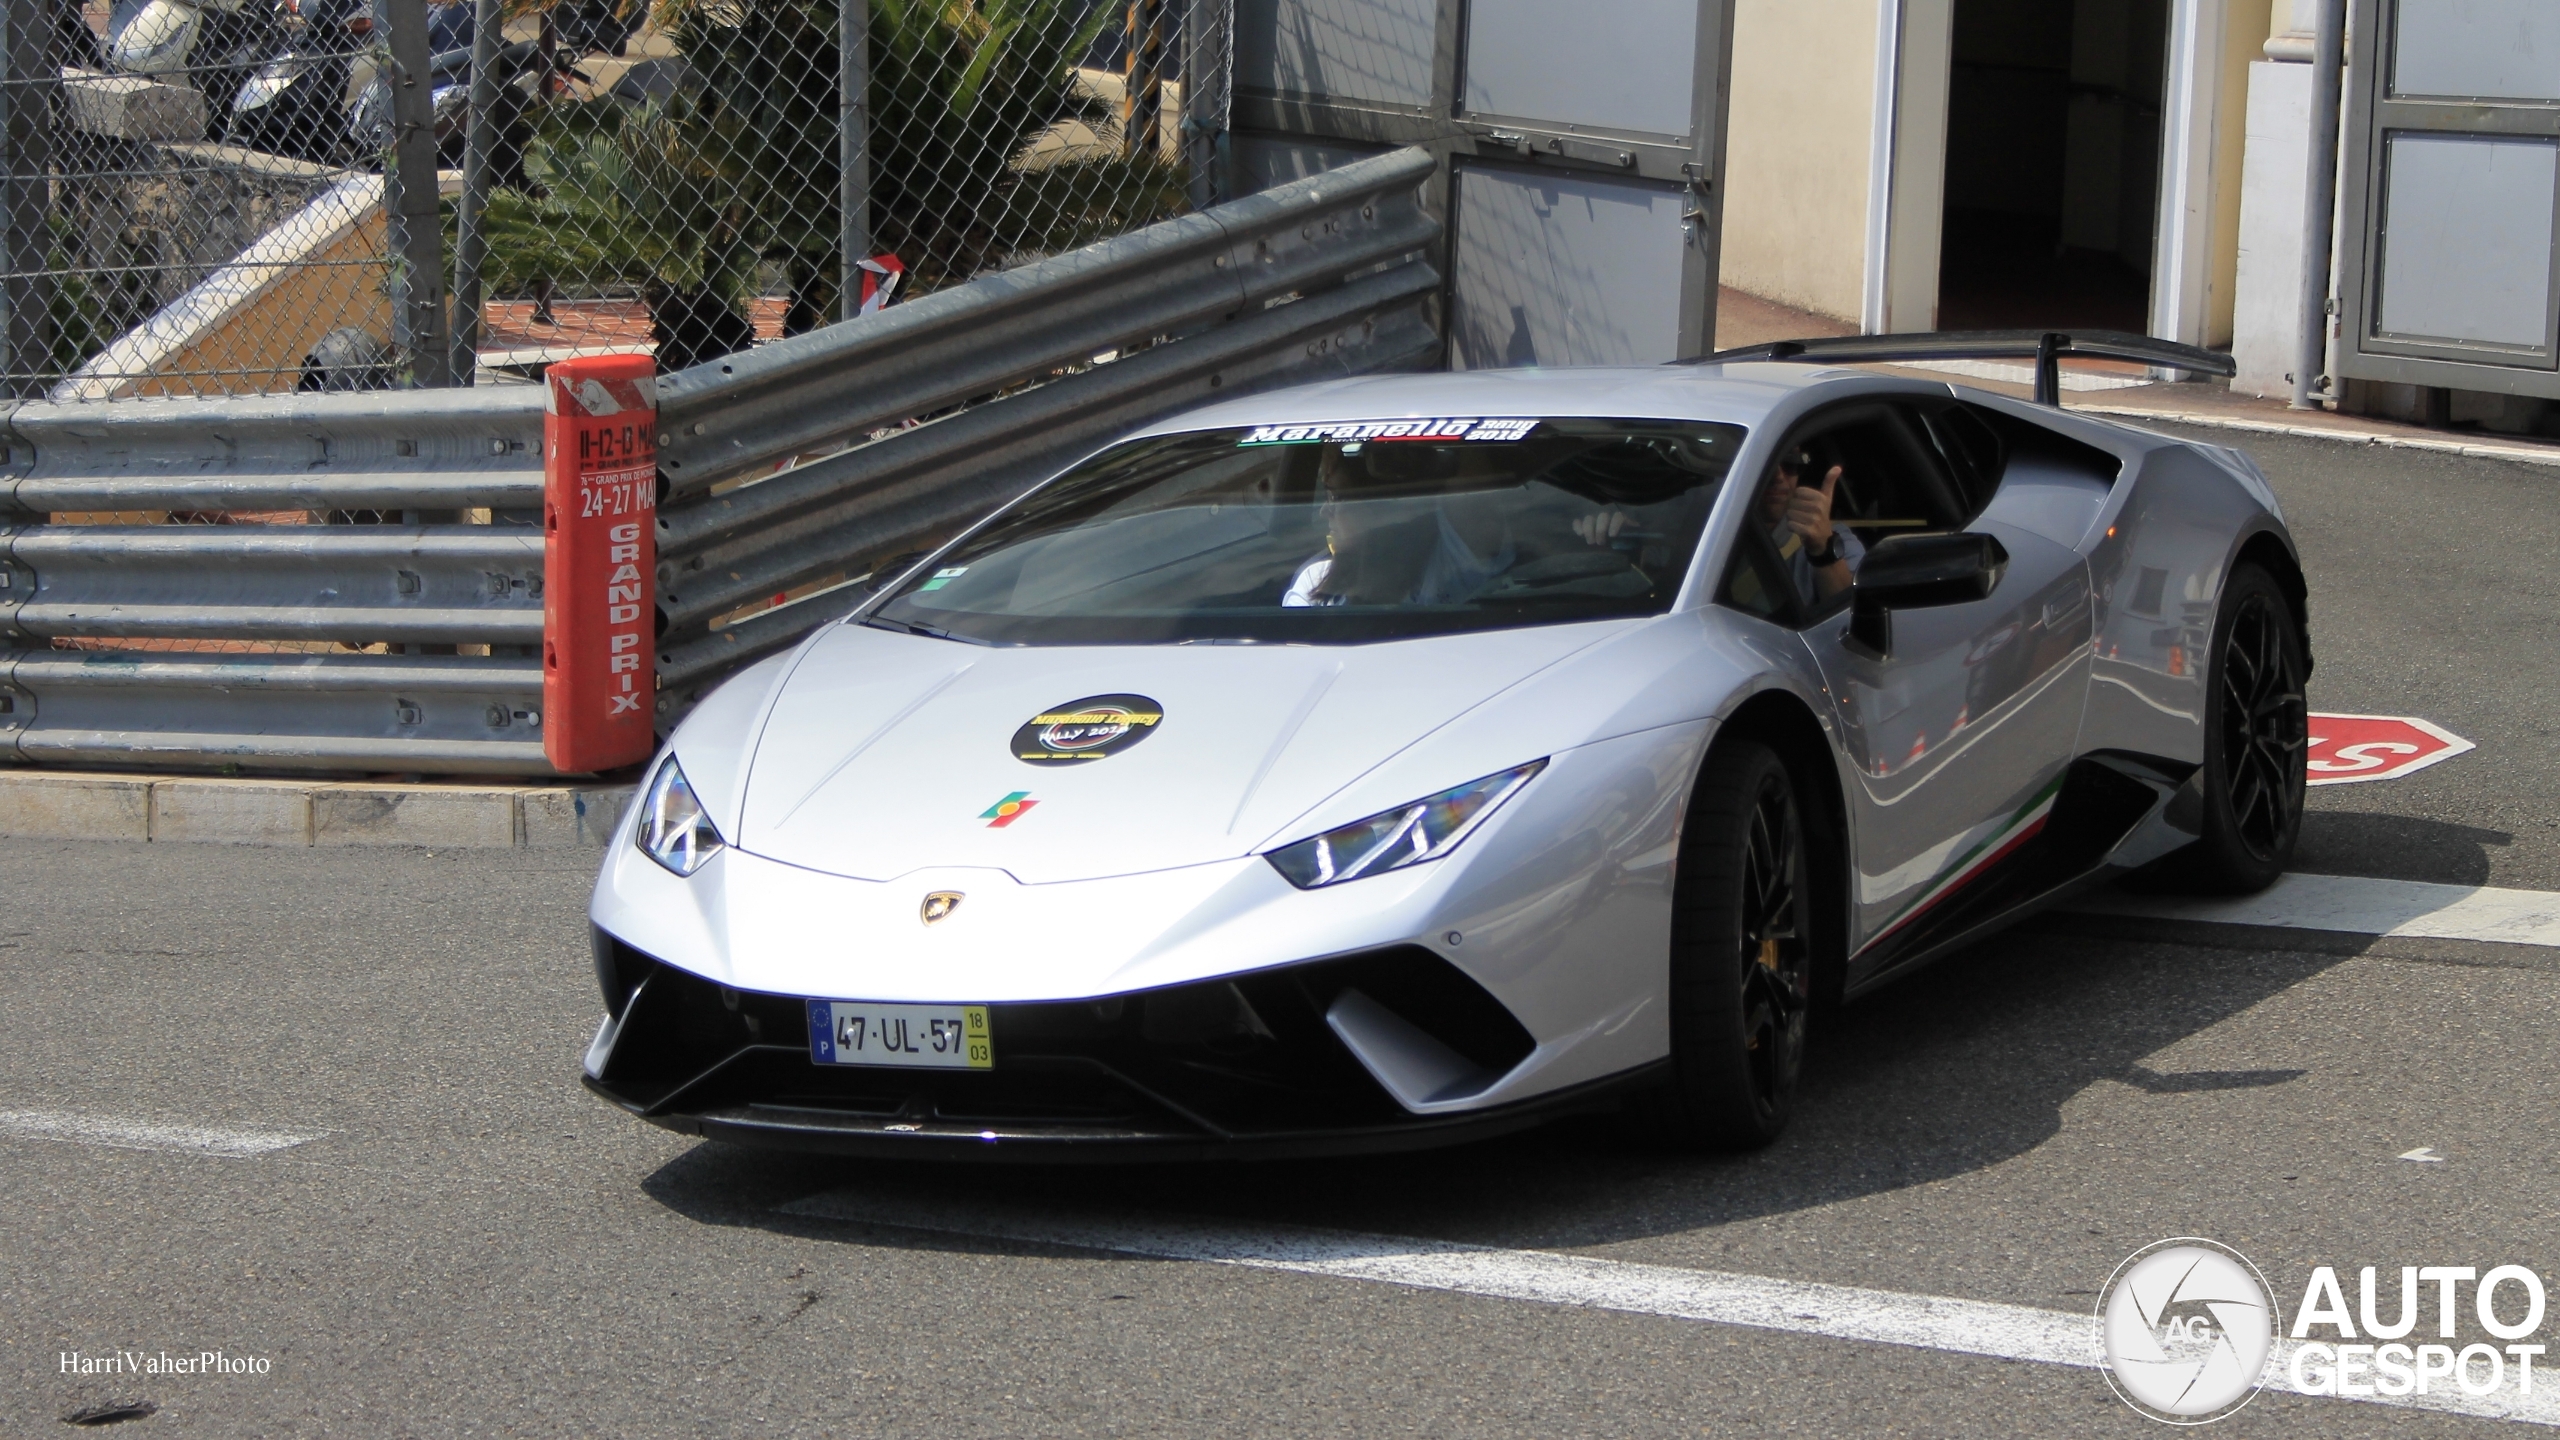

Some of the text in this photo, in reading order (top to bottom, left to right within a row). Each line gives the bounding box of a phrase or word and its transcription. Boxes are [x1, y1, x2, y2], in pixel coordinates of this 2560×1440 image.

[1241, 420, 1479, 443] Maranello
[1464, 430, 1527, 441] 2018
[595, 474, 619, 485] GRAND
[620, 472, 632, 482] PRIX
[581, 485, 631, 517] 24-27
[608, 523, 641, 715] GRAND PRIX
[968, 1013, 983, 1029] 18
[821, 1041, 829, 1055] P
[970, 1045, 988, 1061] 03
